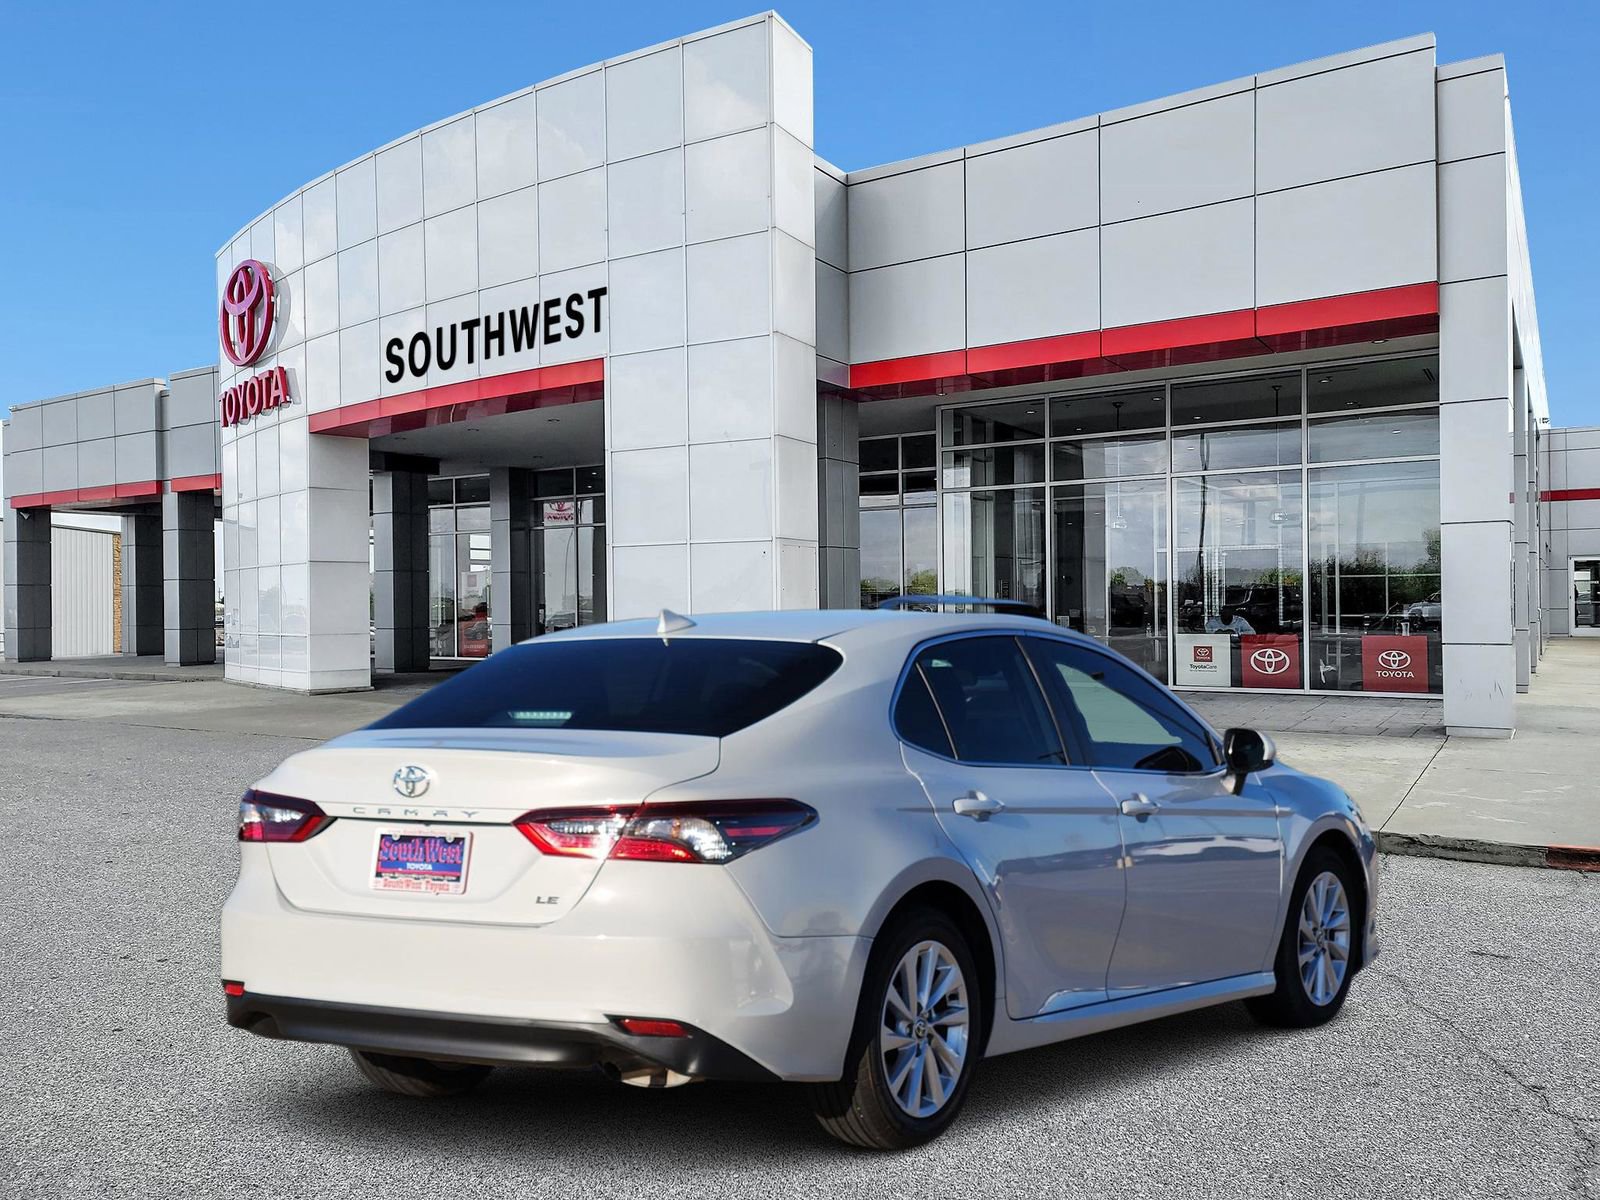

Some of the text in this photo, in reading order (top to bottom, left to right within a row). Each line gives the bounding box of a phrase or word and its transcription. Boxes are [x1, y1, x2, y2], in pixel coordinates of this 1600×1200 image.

[385, 287, 607, 383] SOUTHWEST
[218, 366, 289, 427] TOYOTA
[1376, 670, 1414, 678] TOYOTA
[406, 862, 432, 871] TOYOTA
[535, 896, 560, 905] LE
